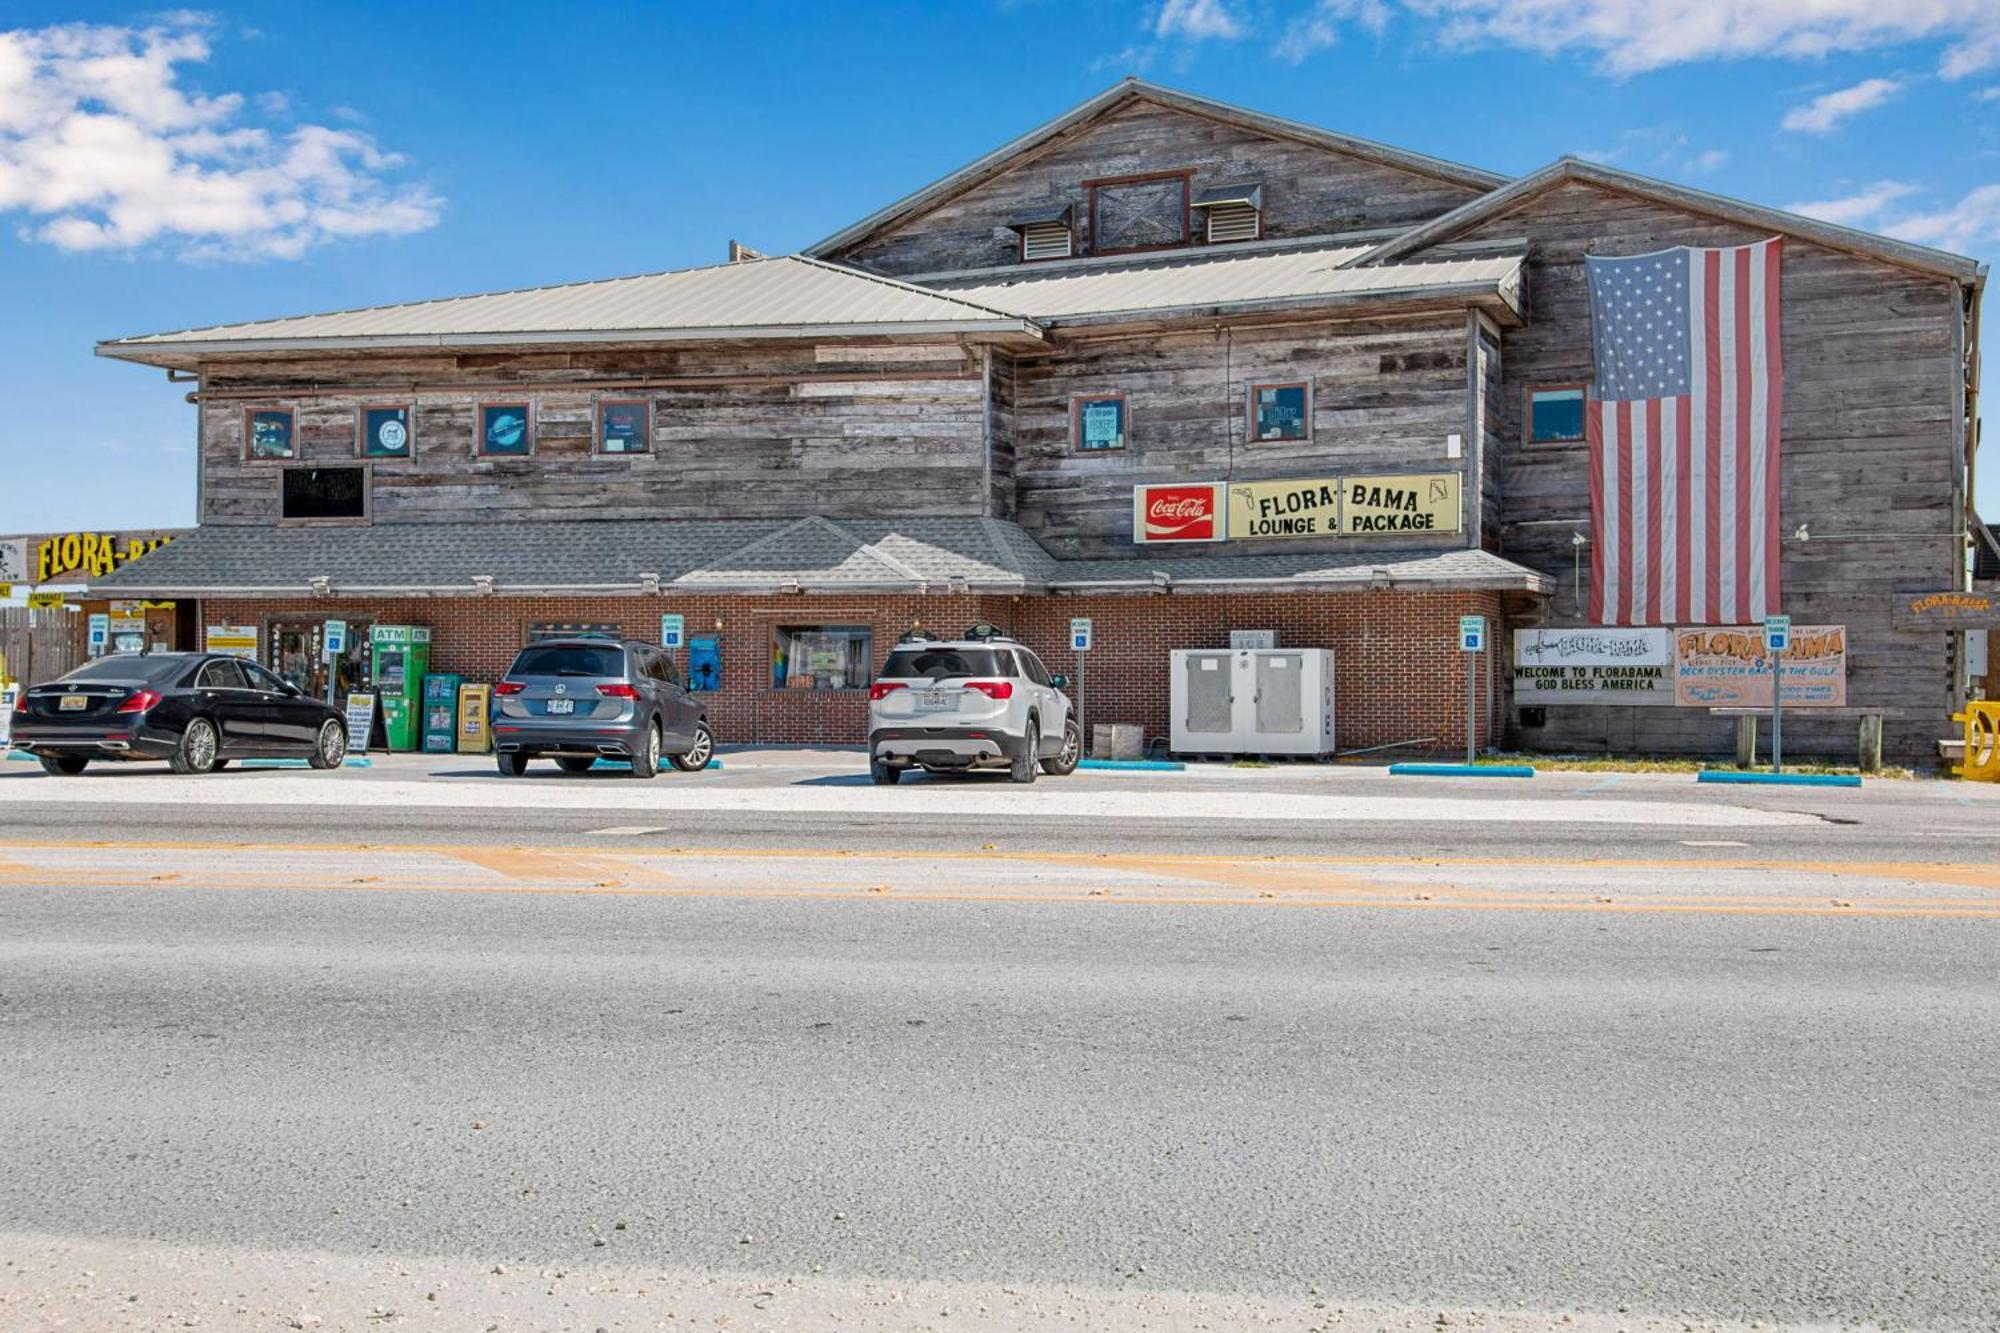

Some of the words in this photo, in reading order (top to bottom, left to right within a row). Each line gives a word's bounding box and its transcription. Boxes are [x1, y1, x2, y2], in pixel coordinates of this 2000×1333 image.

[1249, 518, 1317, 536] LOUNGE
[1327, 517, 1337, 531] &
[1352, 513, 1435, 532] PACKAGE
[376, 628, 405, 640] ATM
[1514, 666, 1566, 678] WELCOME
[1572, 666, 1587, 678] TO
[1593, 666, 1662, 678] FLORABAMA
[1535, 679, 1557, 690] GOD
[1561, 679, 1595, 690] BLESS
[1601, 679, 1655, 690] AMERICA
